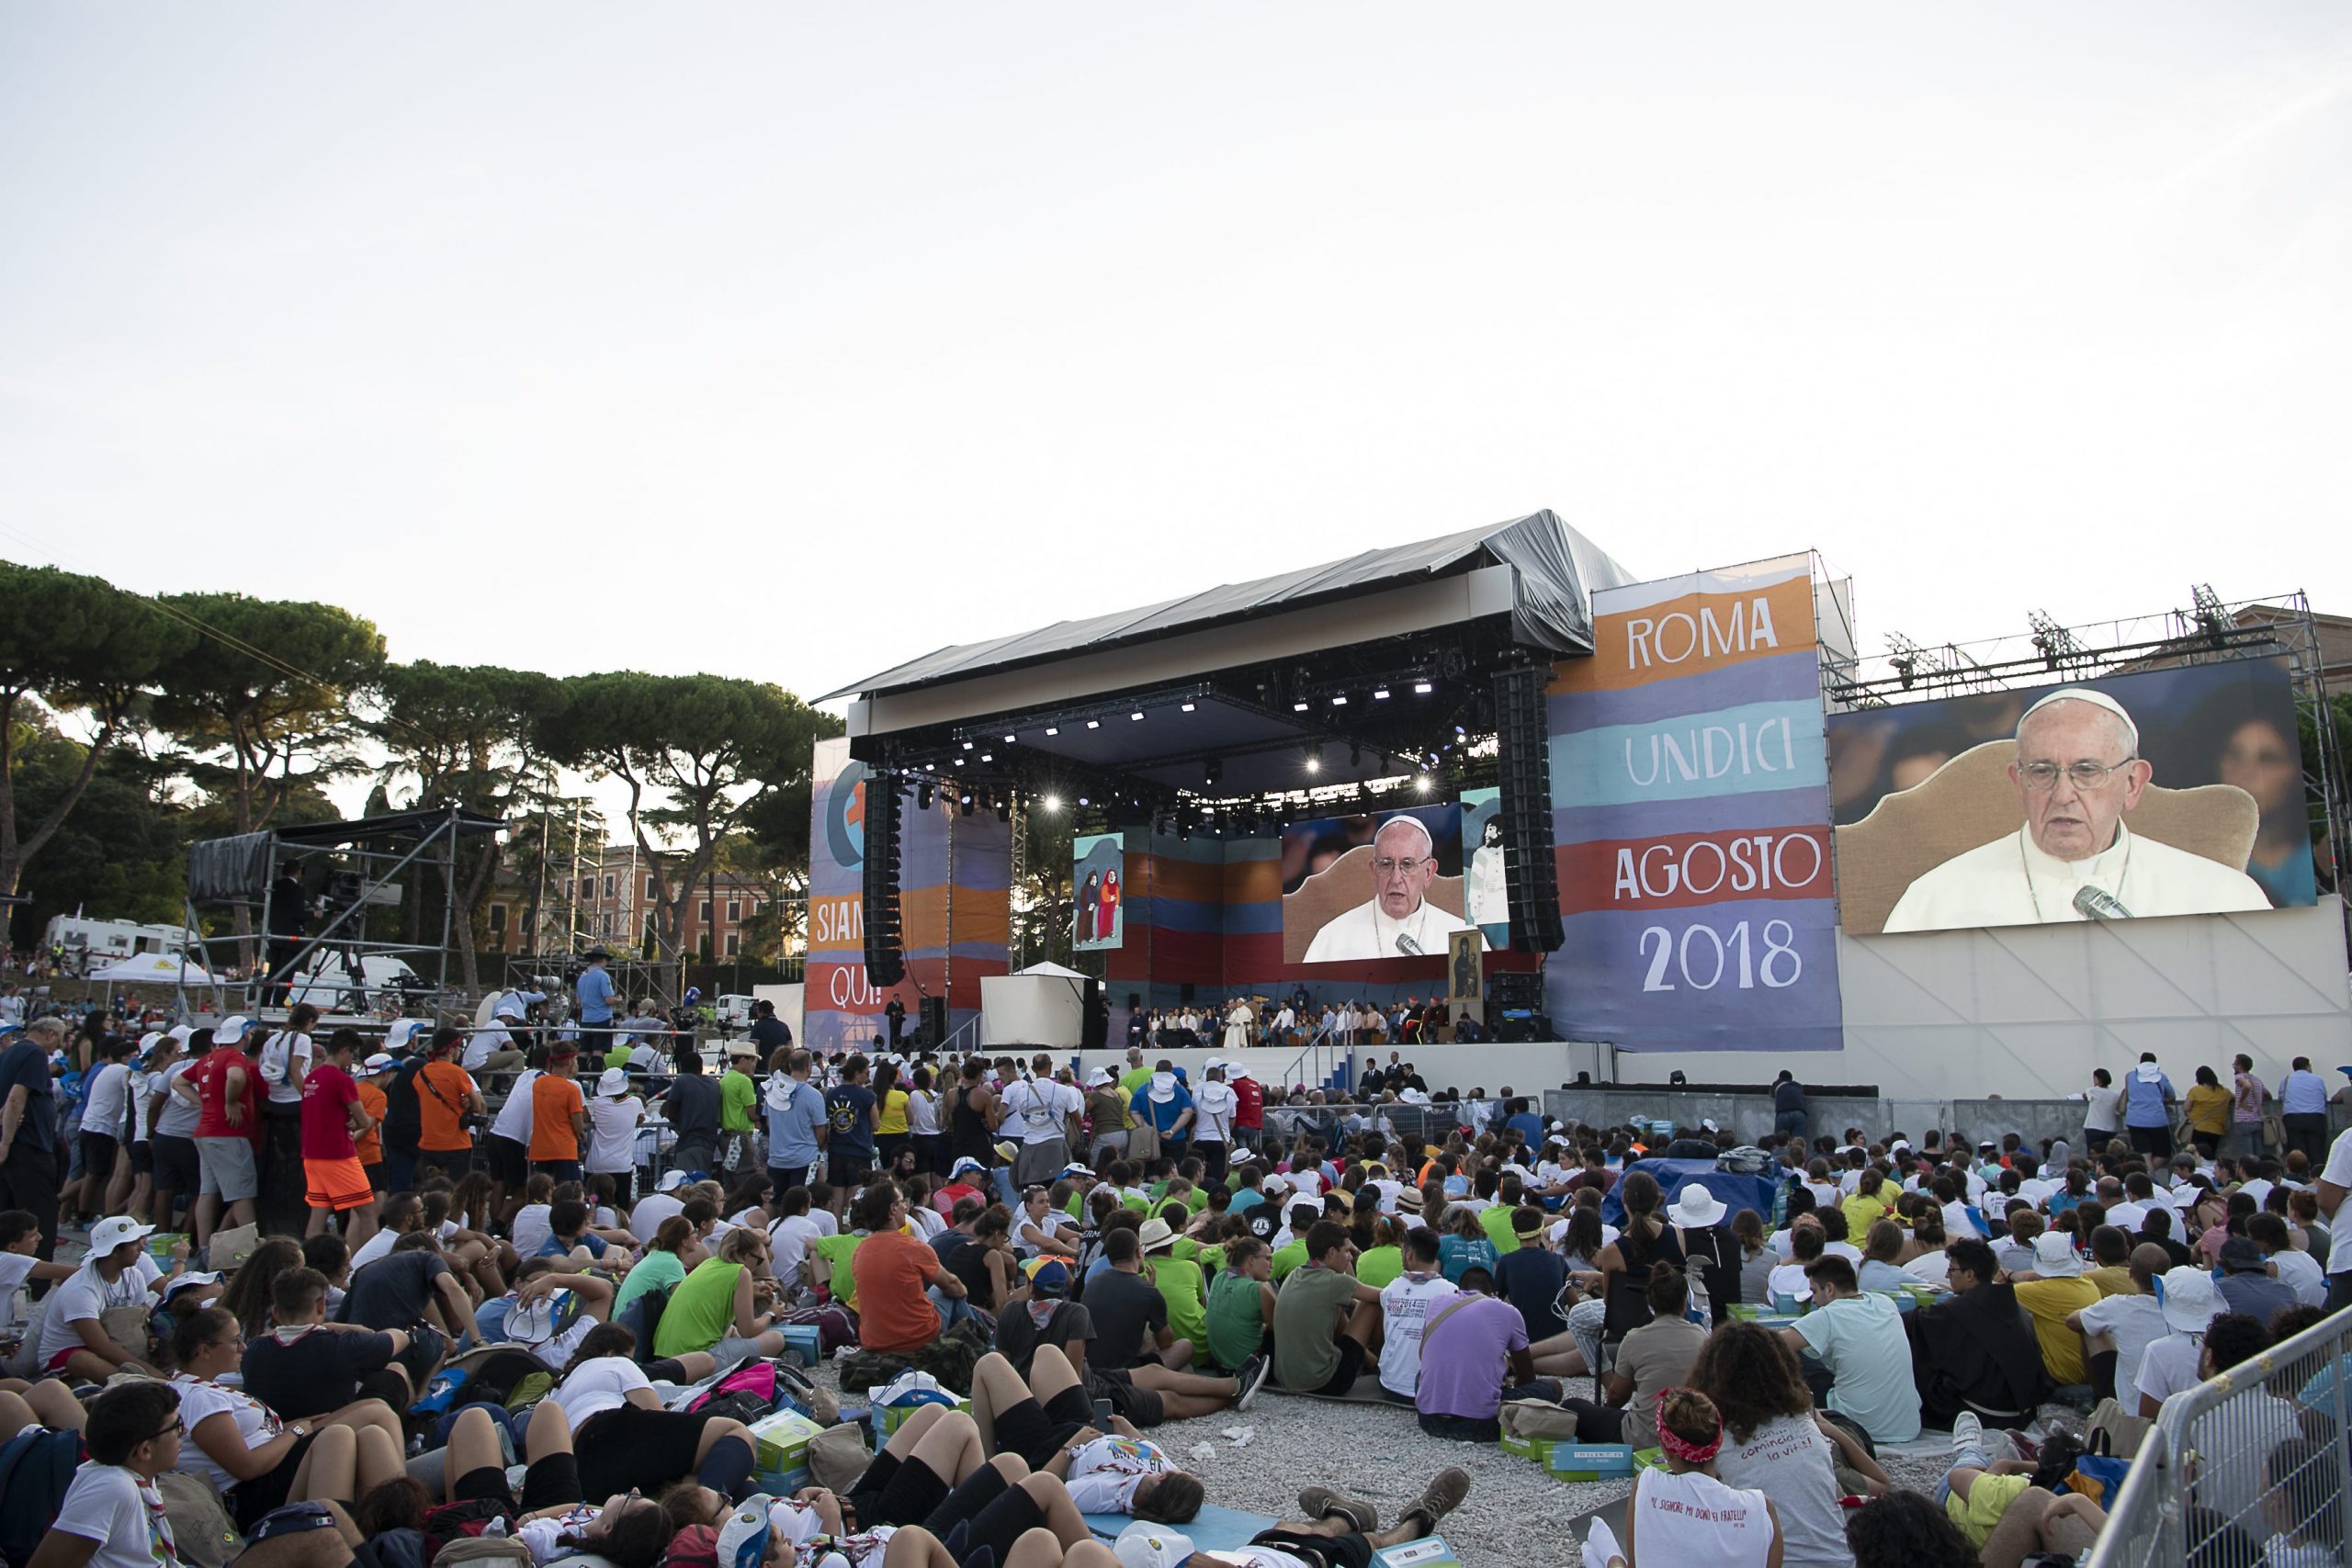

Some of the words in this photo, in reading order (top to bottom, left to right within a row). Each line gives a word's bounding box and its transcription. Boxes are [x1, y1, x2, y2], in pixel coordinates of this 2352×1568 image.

[1627, 597, 1779, 670] ROMA
[1625, 716, 1795, 786] UNDICI
[1614, 832, 1822, 900] AGOSTO
[1639, 919, 1802, 992] 2018
[1741, 1434, 1793, 1460] comincia
[1767, 1452, 1780, 1462] la
[1659, 1499, 1684, 1513] SIGNORE
[1685, 1505, 1694, 1517] MI
